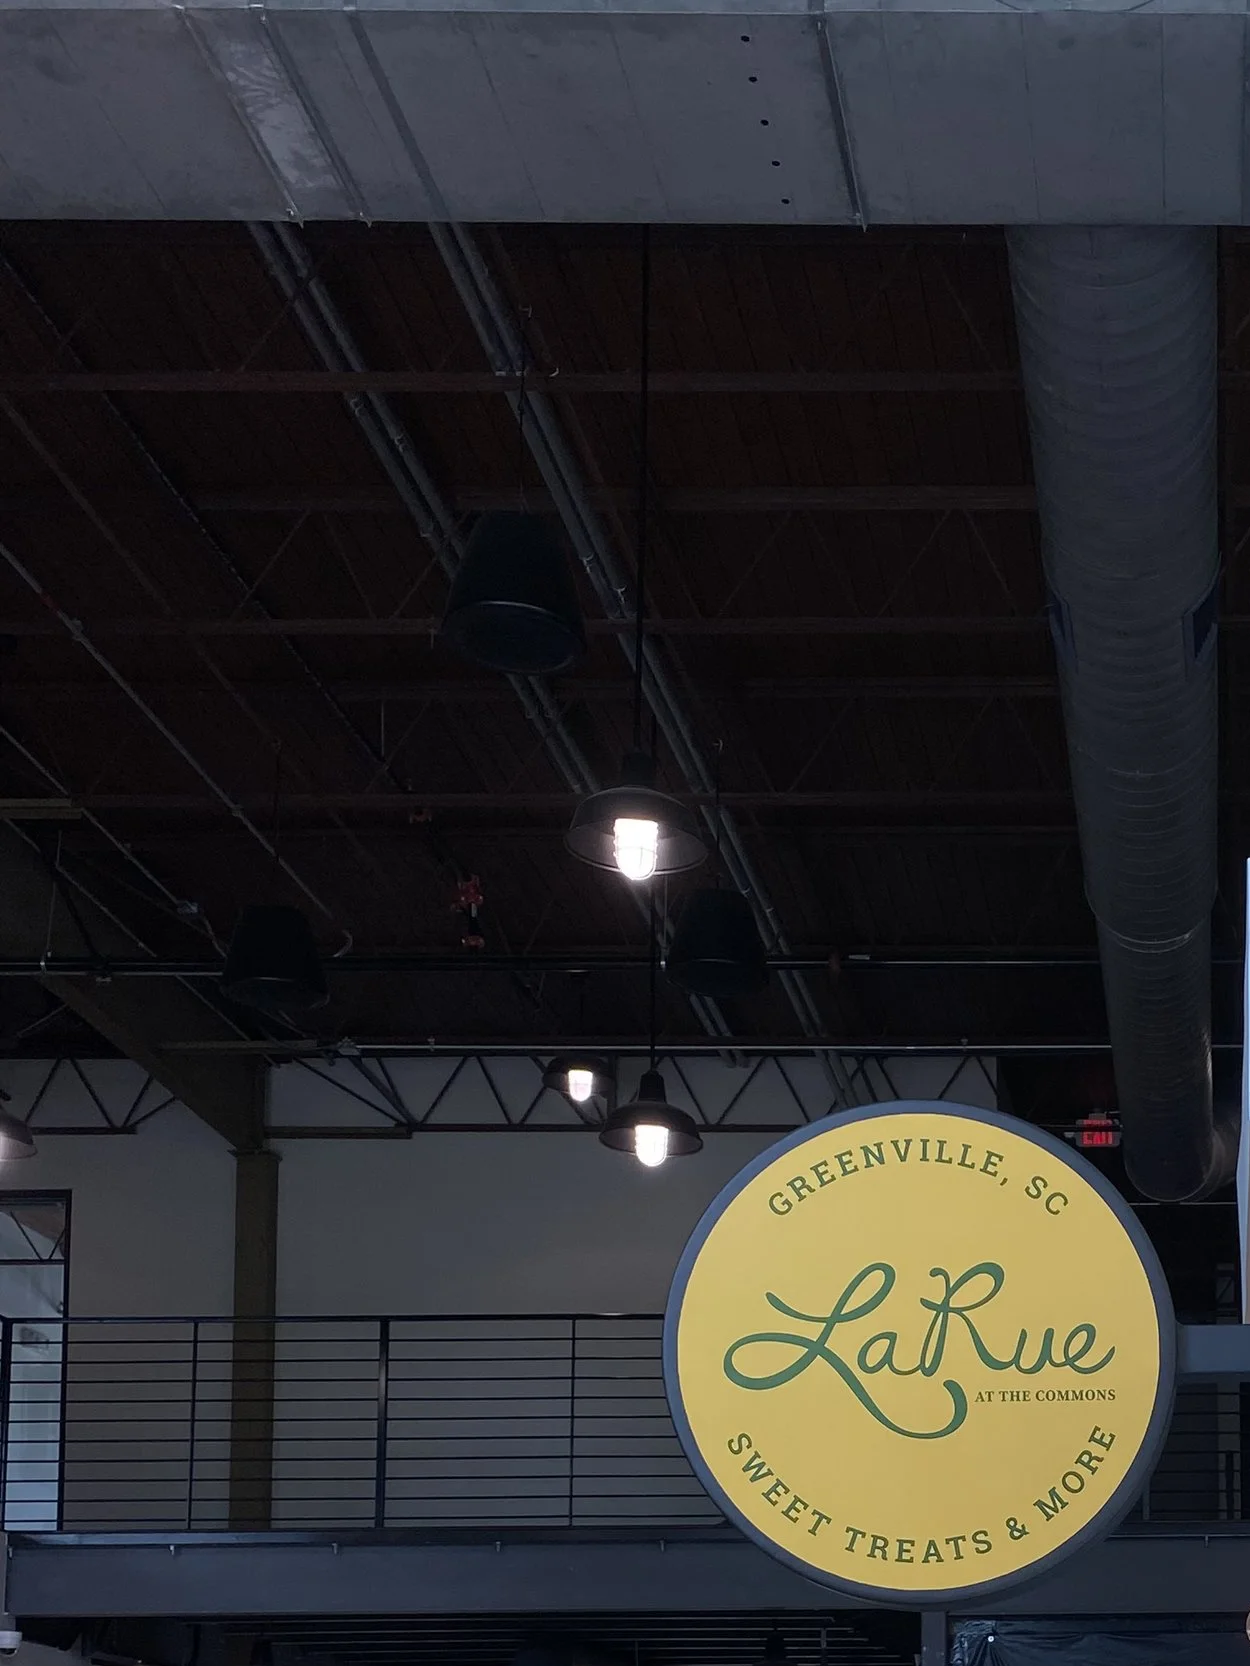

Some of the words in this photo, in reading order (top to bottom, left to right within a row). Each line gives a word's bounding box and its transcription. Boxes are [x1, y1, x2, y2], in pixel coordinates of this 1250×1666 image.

[768, 1138, 1008, 1216] GREENVILLE,
[1025, 1175, 1069, 1216] SC
[723, 1261, 1116, 1440] LaRue
[974, 1390, 995, 1402] AT
[998, 1390, 1032, 1402] THE
[1035, 1389, 1117, 1402] COMMONS
[727, 1432, 832, 1537] SWEET
[845, 1524, 993, 1564] TREATS
[1006, 1516, 1029, 1541] &
[1033, 1425, 1117, 1521] MORE
